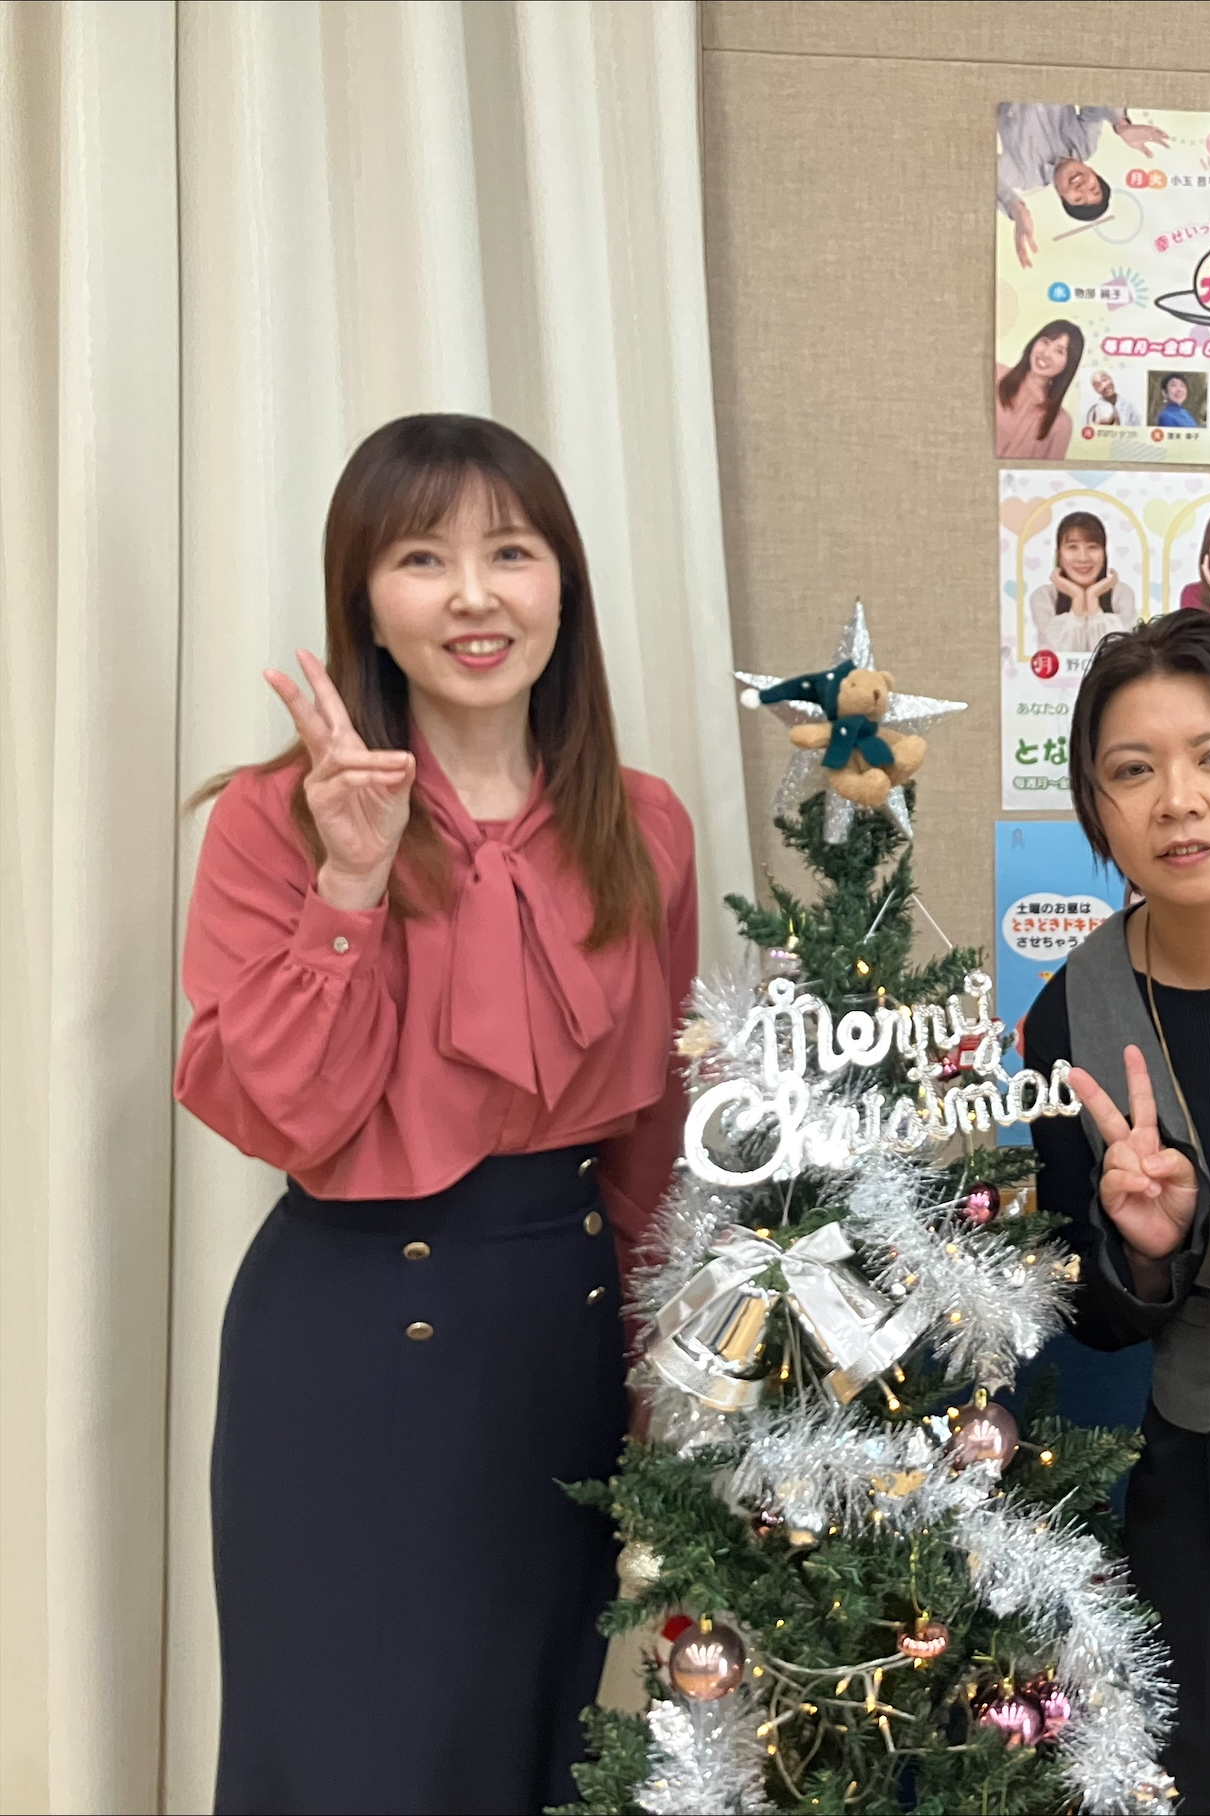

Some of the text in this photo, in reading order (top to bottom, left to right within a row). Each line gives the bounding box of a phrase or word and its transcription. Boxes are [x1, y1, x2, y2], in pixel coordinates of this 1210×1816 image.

[1171, 175, 1193, 187] 小玉
[1016, 902, 1091, 915] 土曜のお昼は
[1012, 916, 1107, 933] ときどきドキド
